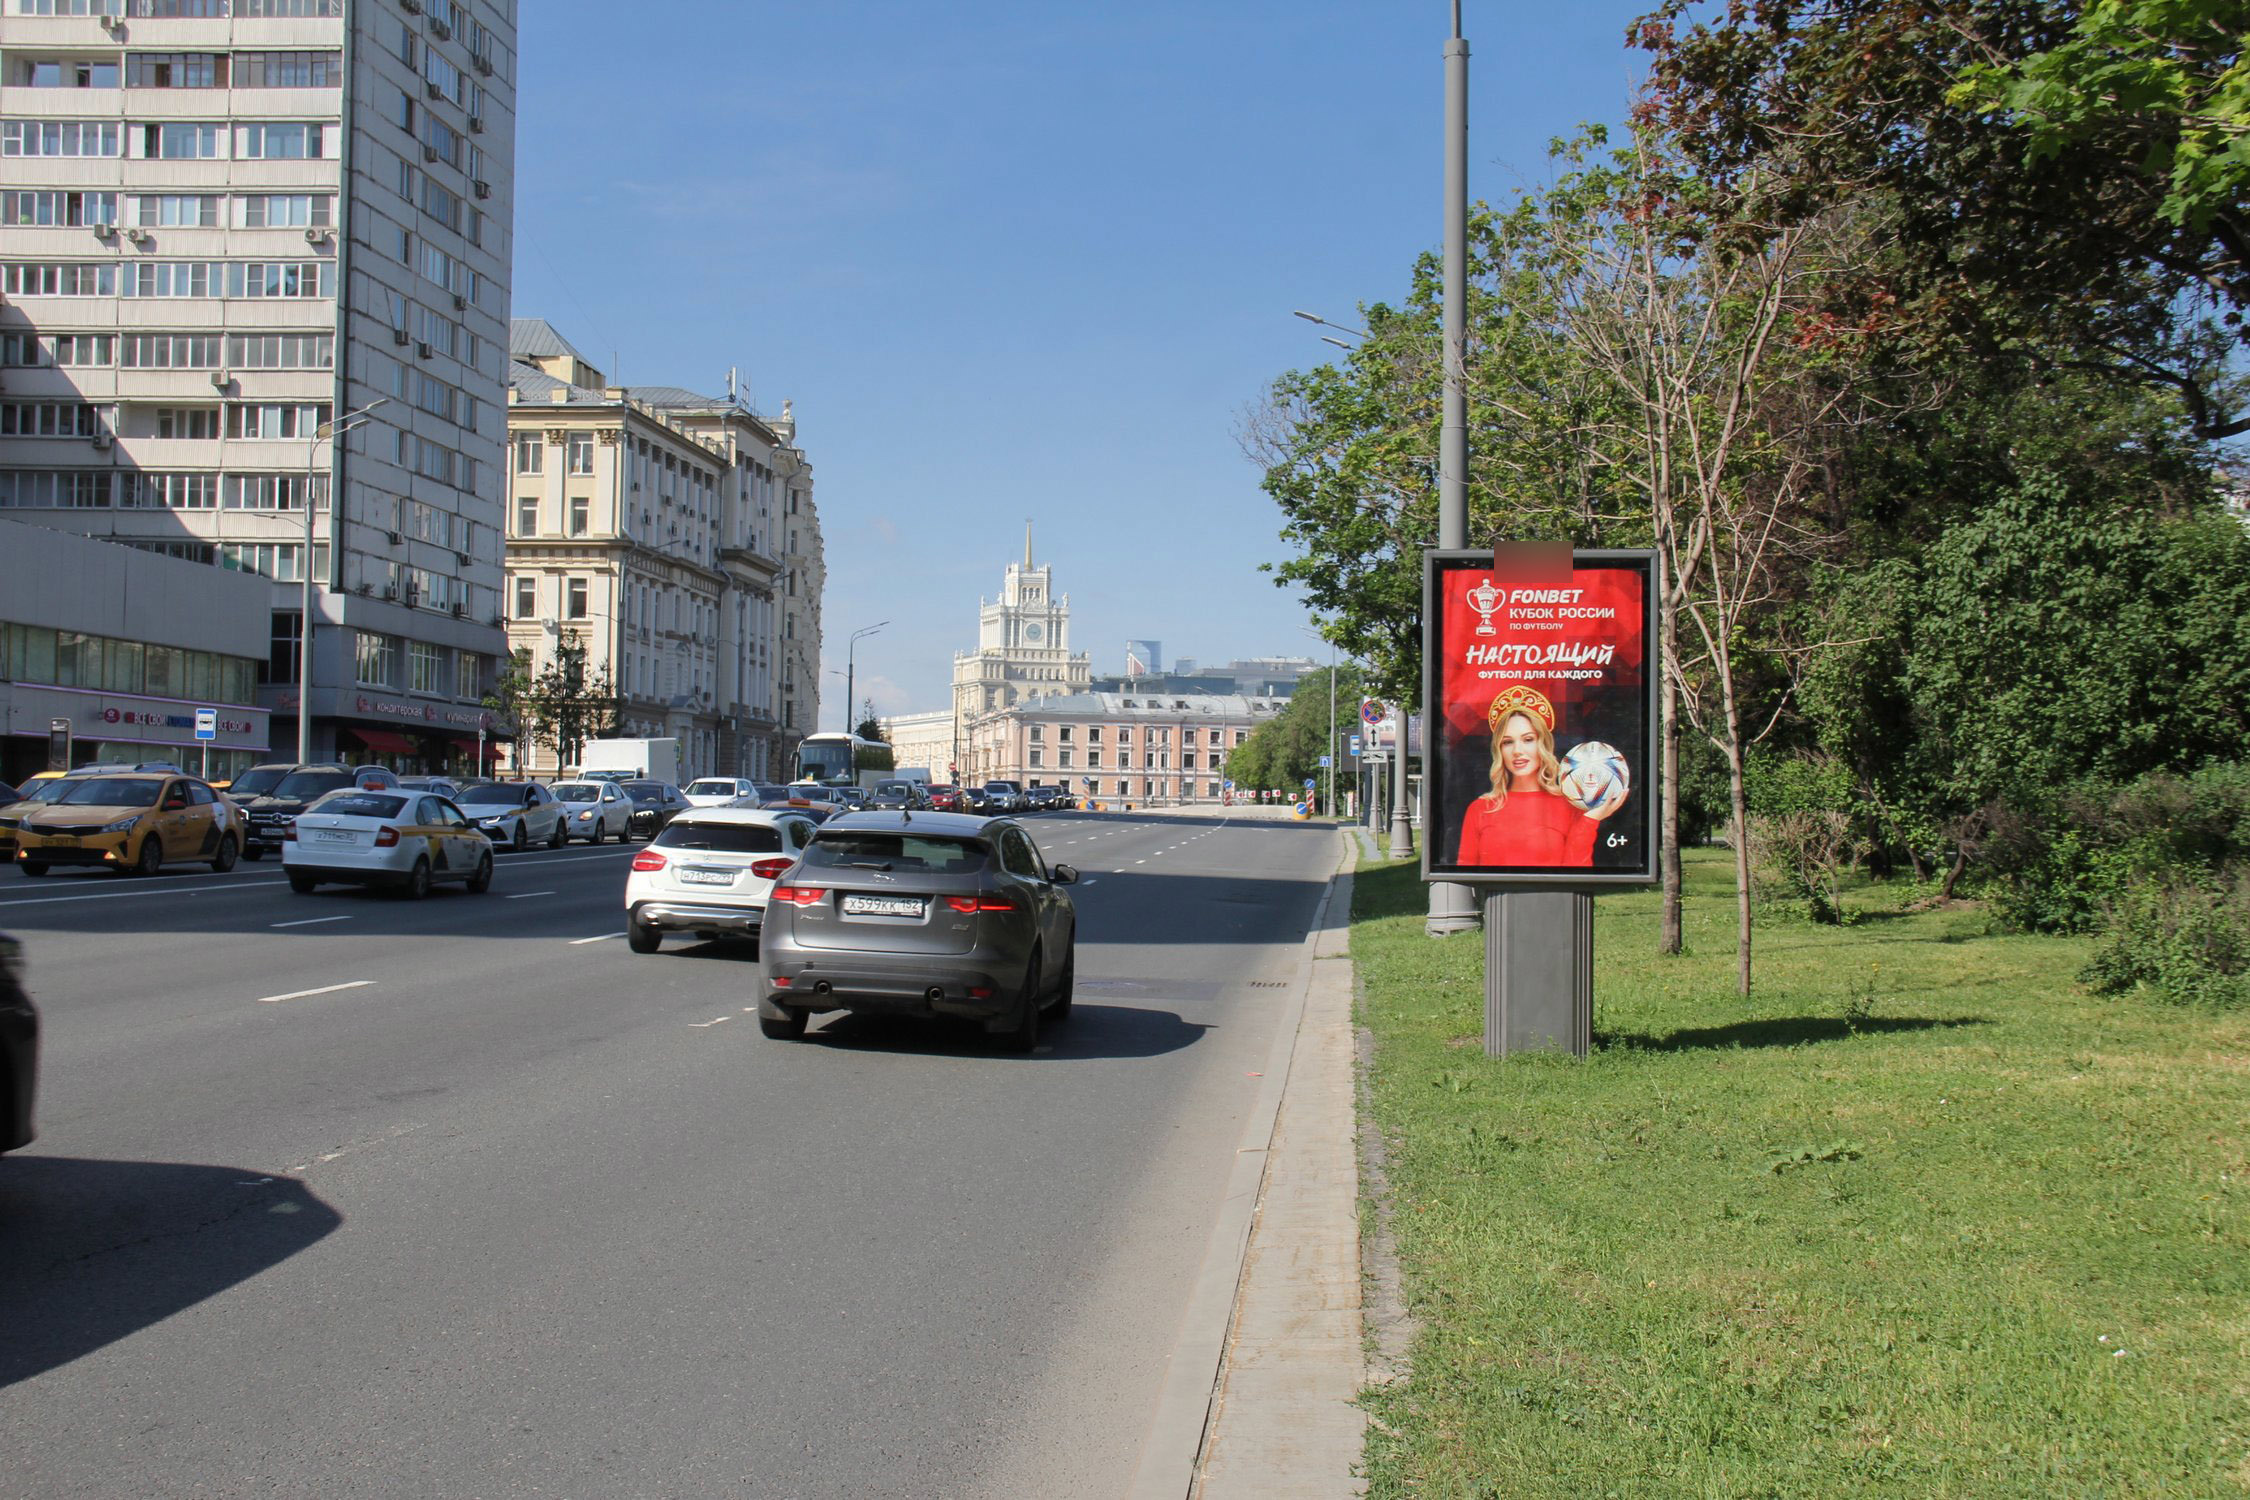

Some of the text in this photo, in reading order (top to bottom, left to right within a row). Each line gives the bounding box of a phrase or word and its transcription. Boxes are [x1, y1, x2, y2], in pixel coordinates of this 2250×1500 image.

[1509, 588, 1584, 605] FONBET
[1509, 607, 1615, 619] КУБОК РОССИИ
[1509, 622, 1564, 631] ПО ФУТБОЛУ
[1465, 641, 1616, 668] НАСТОЯЩИЙ
[1477, 669, 1603, 681] ФУТБОЛ ДЛЯ КАЖДОГО
[1606, 832, 1629, 848] 6+
